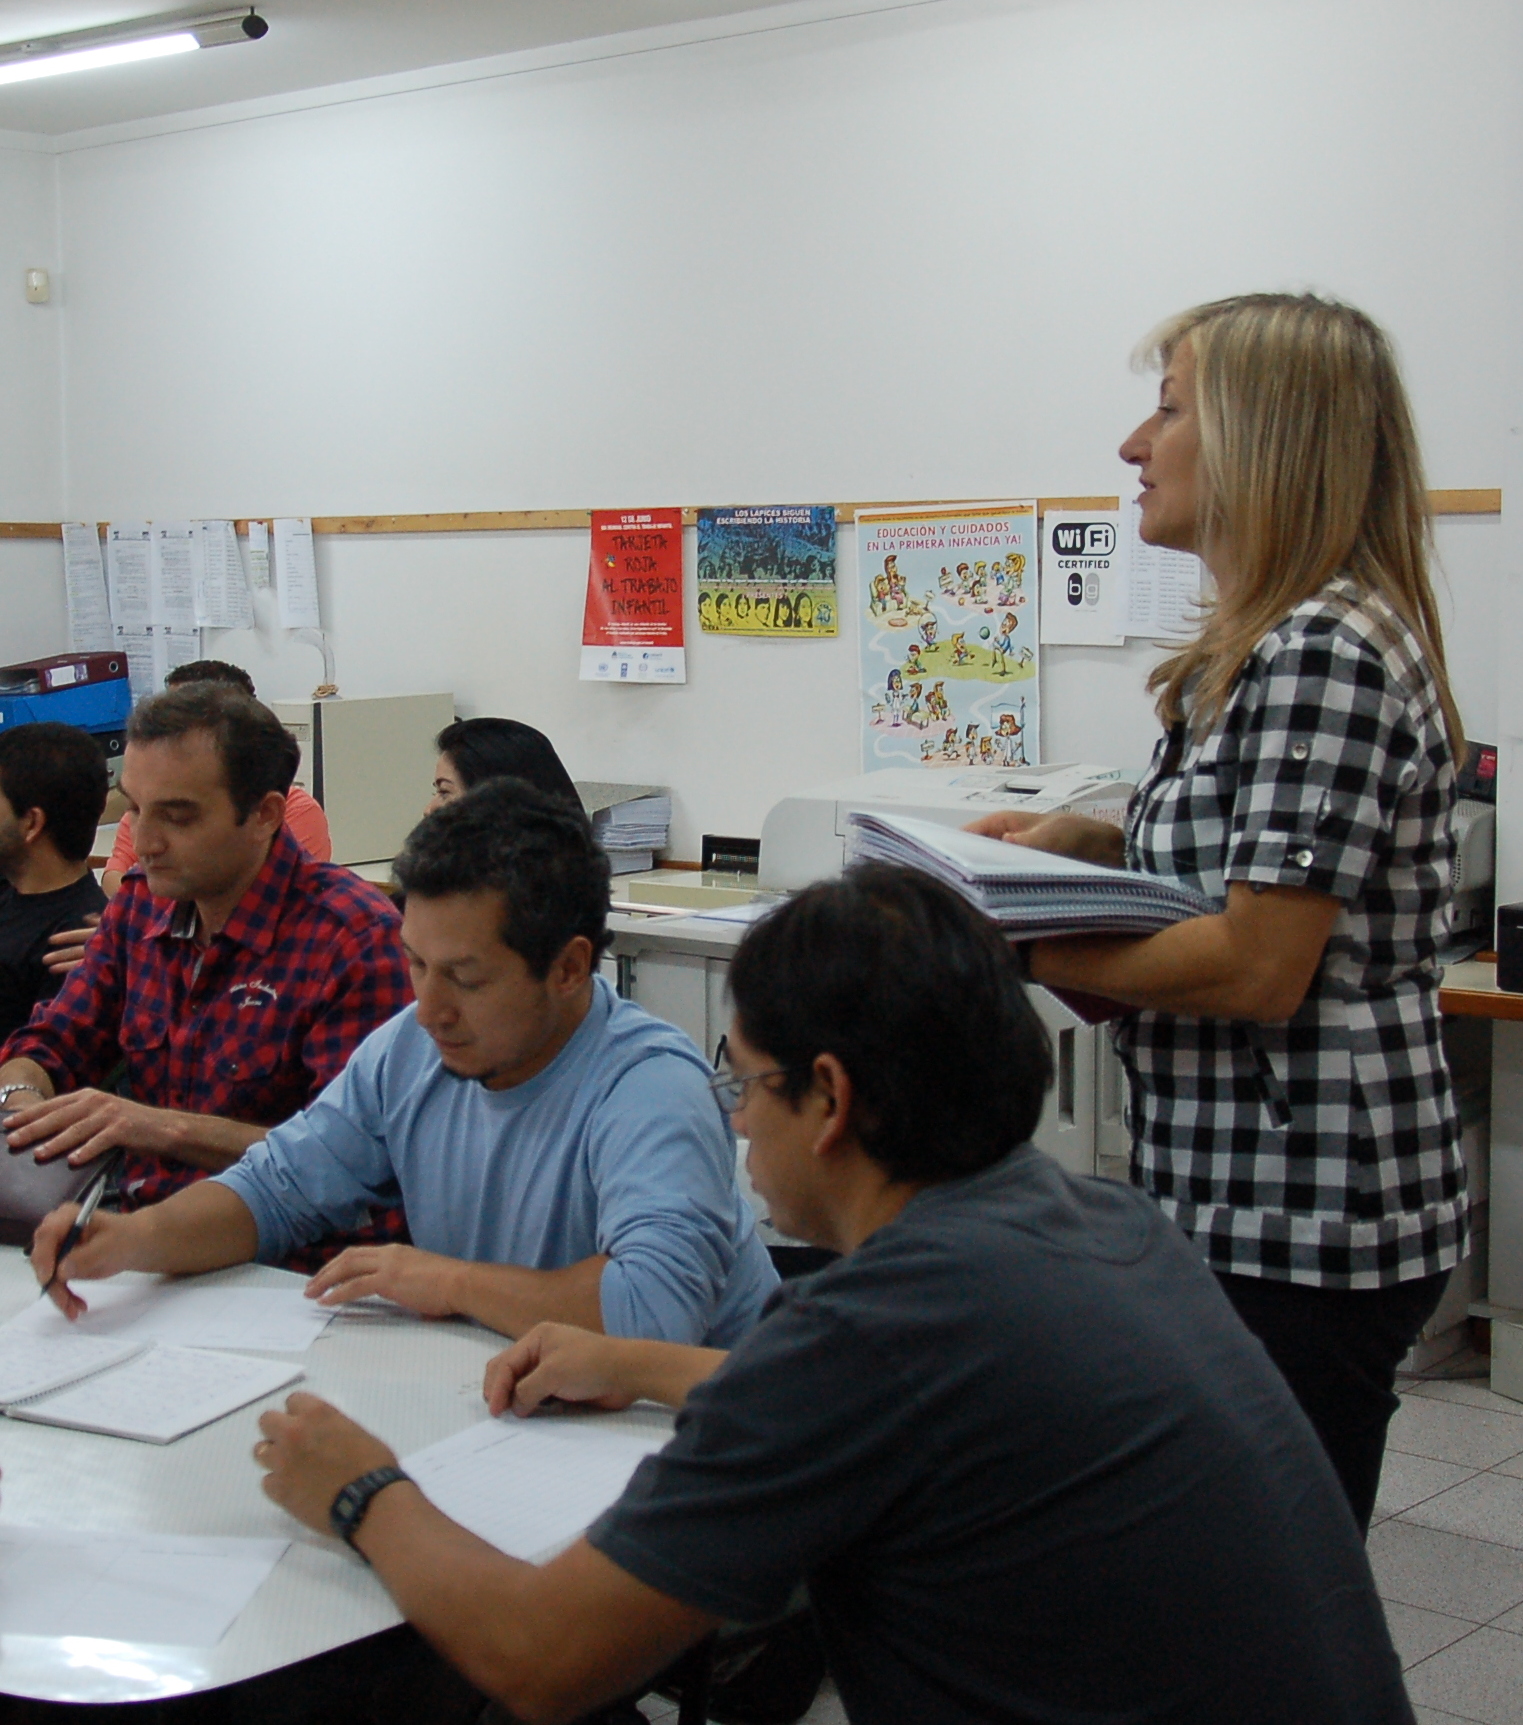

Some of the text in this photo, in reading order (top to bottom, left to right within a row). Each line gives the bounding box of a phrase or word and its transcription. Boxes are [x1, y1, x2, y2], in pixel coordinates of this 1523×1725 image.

[940, 525, 947, 535] Y
[950, 521, 1009, 535] CUIDADOS
[612, 534, 668, 551] TARJETA
[867, 534, 1021, 551] EN LA PRIMERA INFANCIA YA!
[624, 555, 657, 573] ROJA
[1057, 560, 1110, 569] CERTIFIED
[602, 577, 678, 595] AL TRABAJO
[611, 597, 670, 615] INFANTIL
